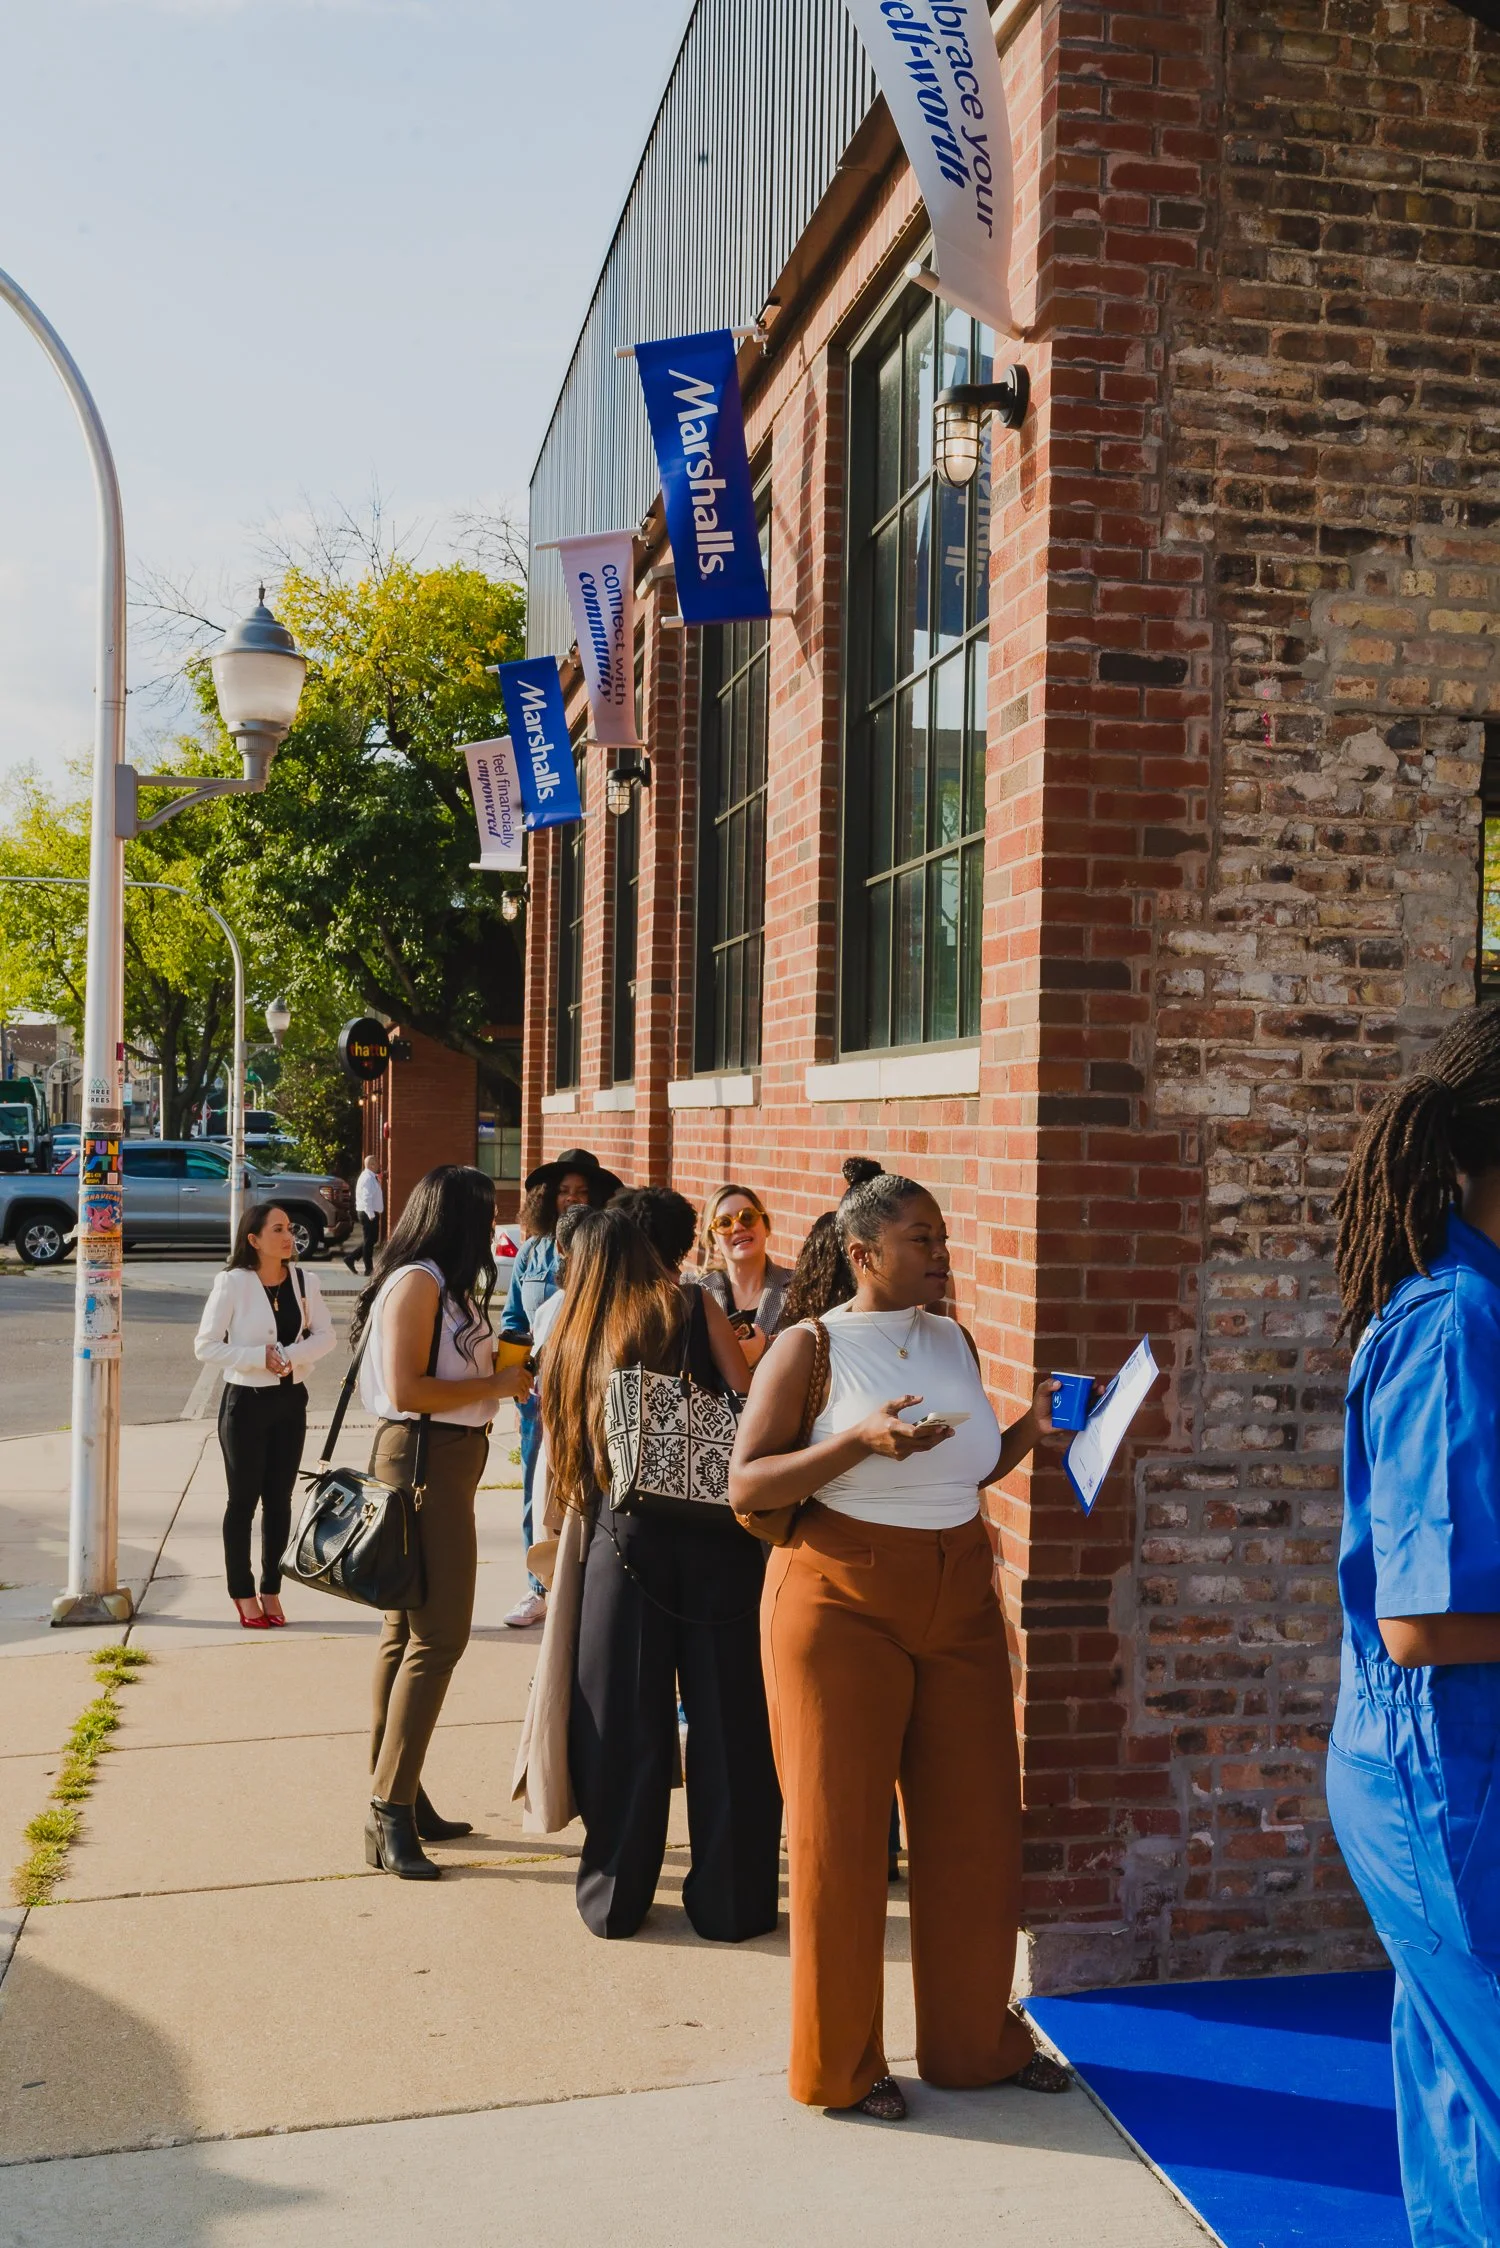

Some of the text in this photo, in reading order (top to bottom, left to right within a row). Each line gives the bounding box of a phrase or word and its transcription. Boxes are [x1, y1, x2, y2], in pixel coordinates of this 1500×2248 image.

[880, 0, 972, 189] elf-worth
[928, 0, 993, 239] brace your
[668, 369, 735, 576] Marshalls
[579, 571, 614, 702] community
[602, 564, 626, 705] connect with
[477, 759, 501, 838] empowered
[492, 753, 515, 848] feel financially
[517, 680, 560, 801] Marshalls
